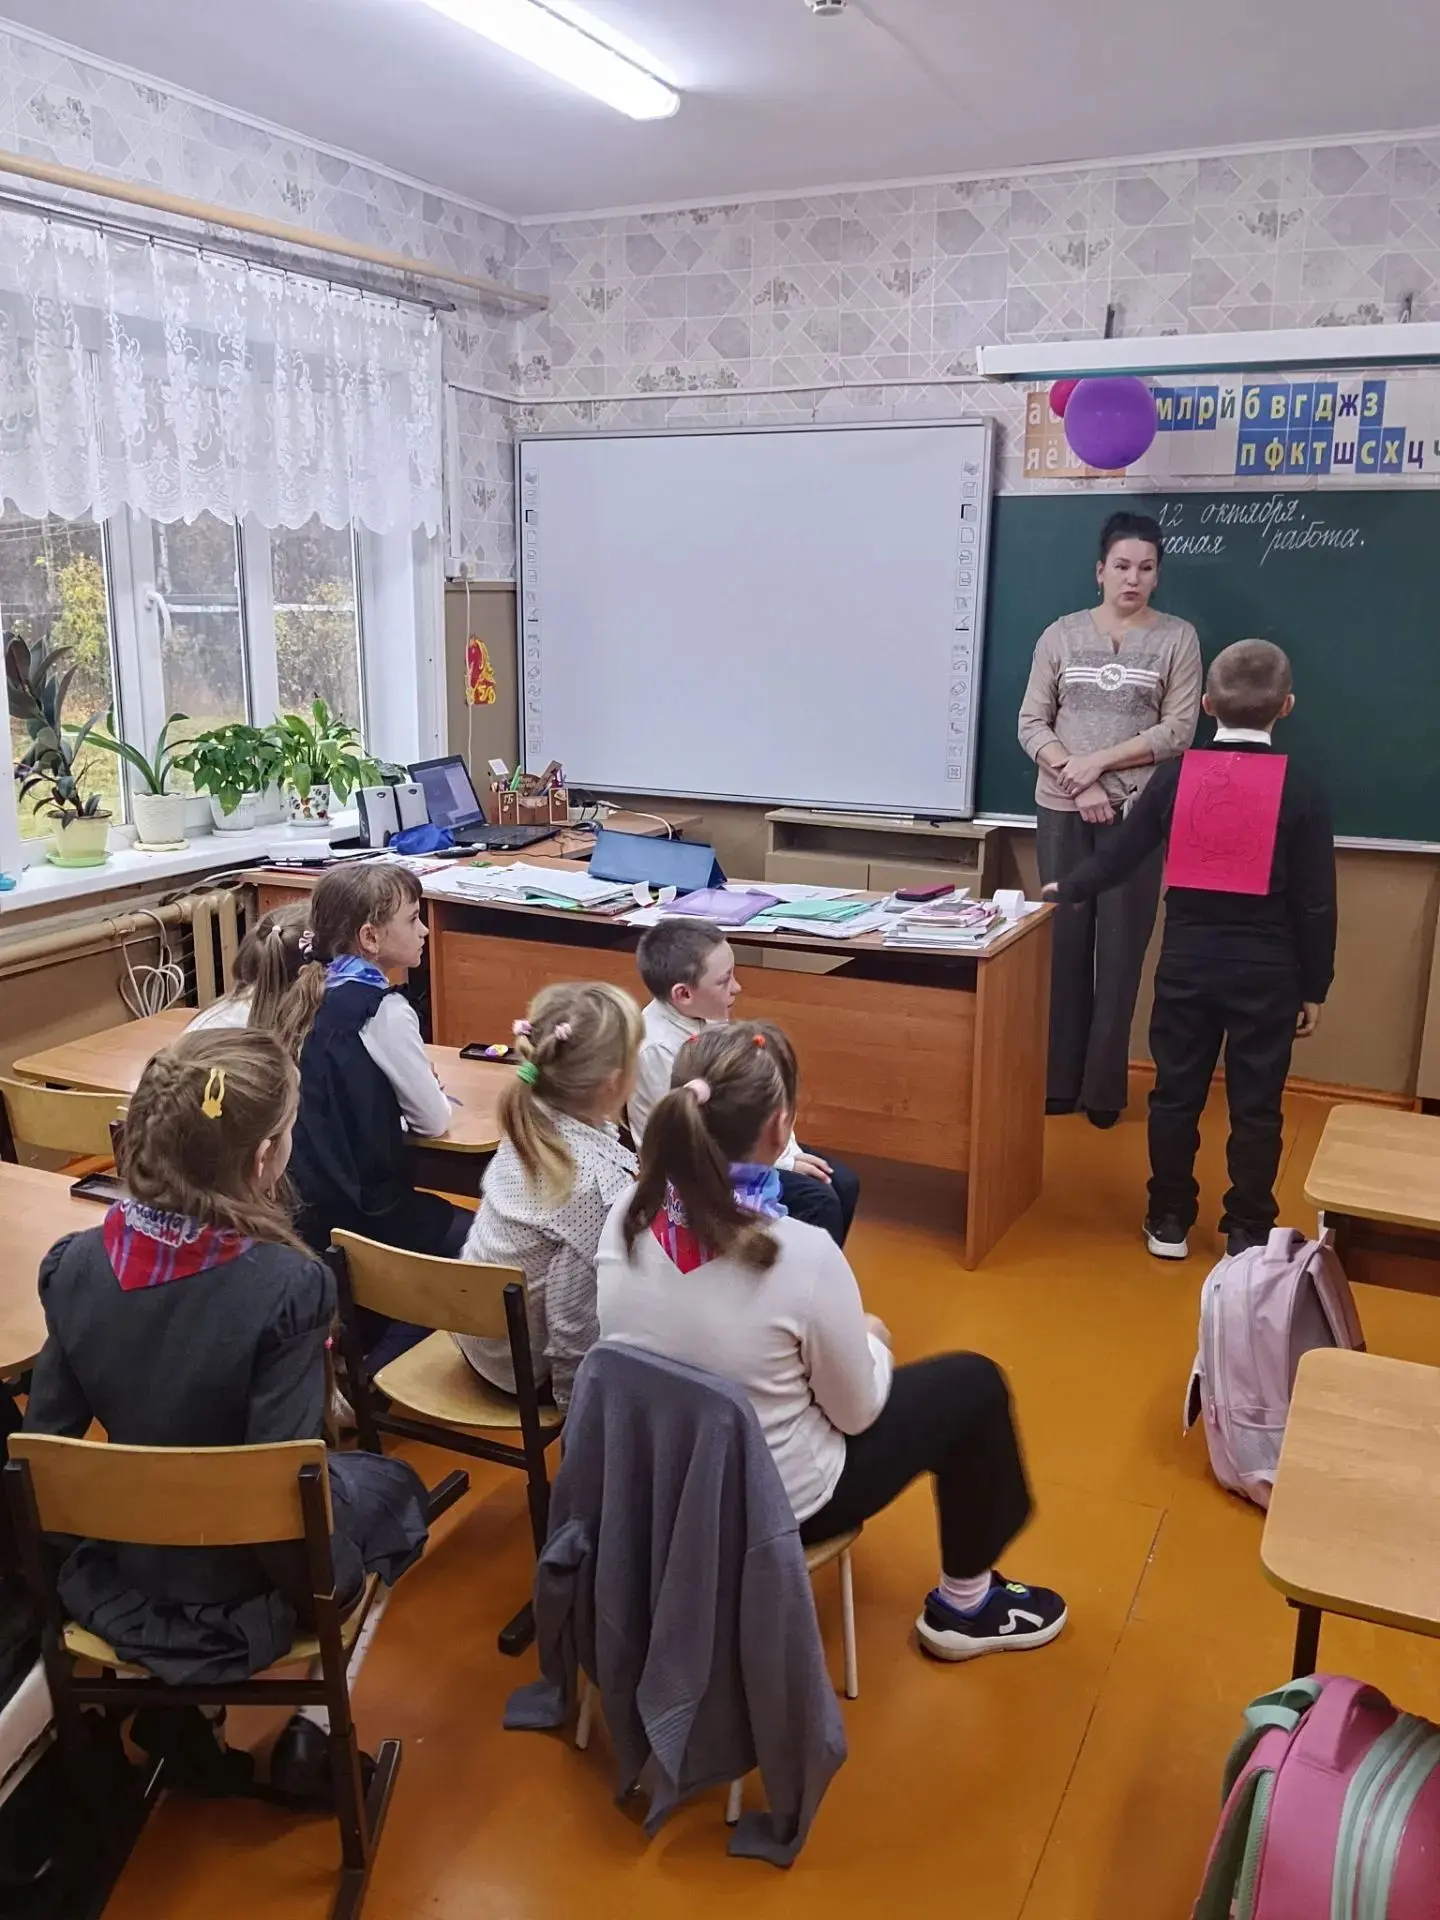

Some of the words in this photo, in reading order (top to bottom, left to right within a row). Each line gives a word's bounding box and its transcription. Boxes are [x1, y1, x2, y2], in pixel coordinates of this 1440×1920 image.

[1158, 502, 1185, 527] 12
[1201, 494, 1305, 537] октября.
[1259, 521, 1365, 568] работа.
